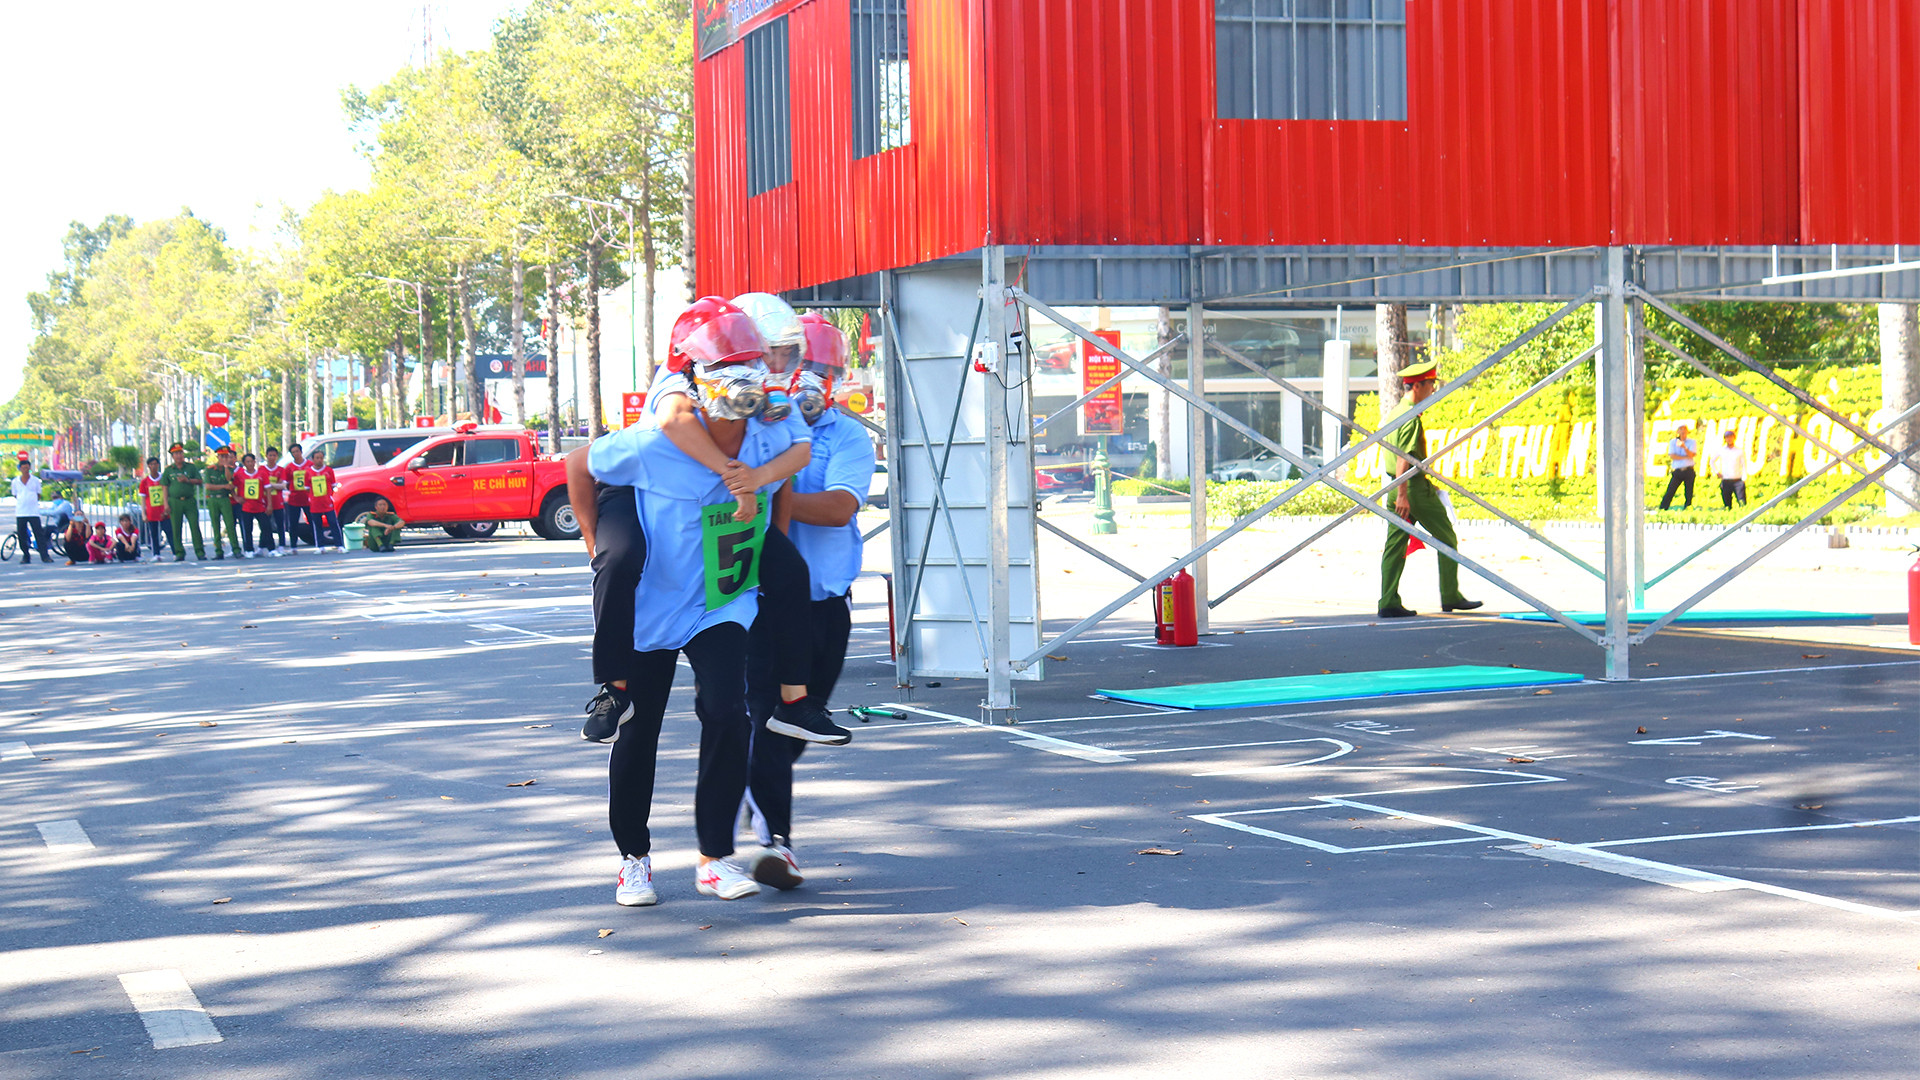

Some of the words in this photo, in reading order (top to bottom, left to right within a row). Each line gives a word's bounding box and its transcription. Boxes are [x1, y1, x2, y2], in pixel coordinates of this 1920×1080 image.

[1341, 324, 1369, 334] arens
[296, 477, 304, 488] 5
[473, 479, 486, 490] XE
[507, 477, 527, 488] HUY
[247, 485, 256, 496] 6
[317, 483, 323, 494] 1
[152, 492, 161, 504] 2
[717, 526, 756, 595] 5
